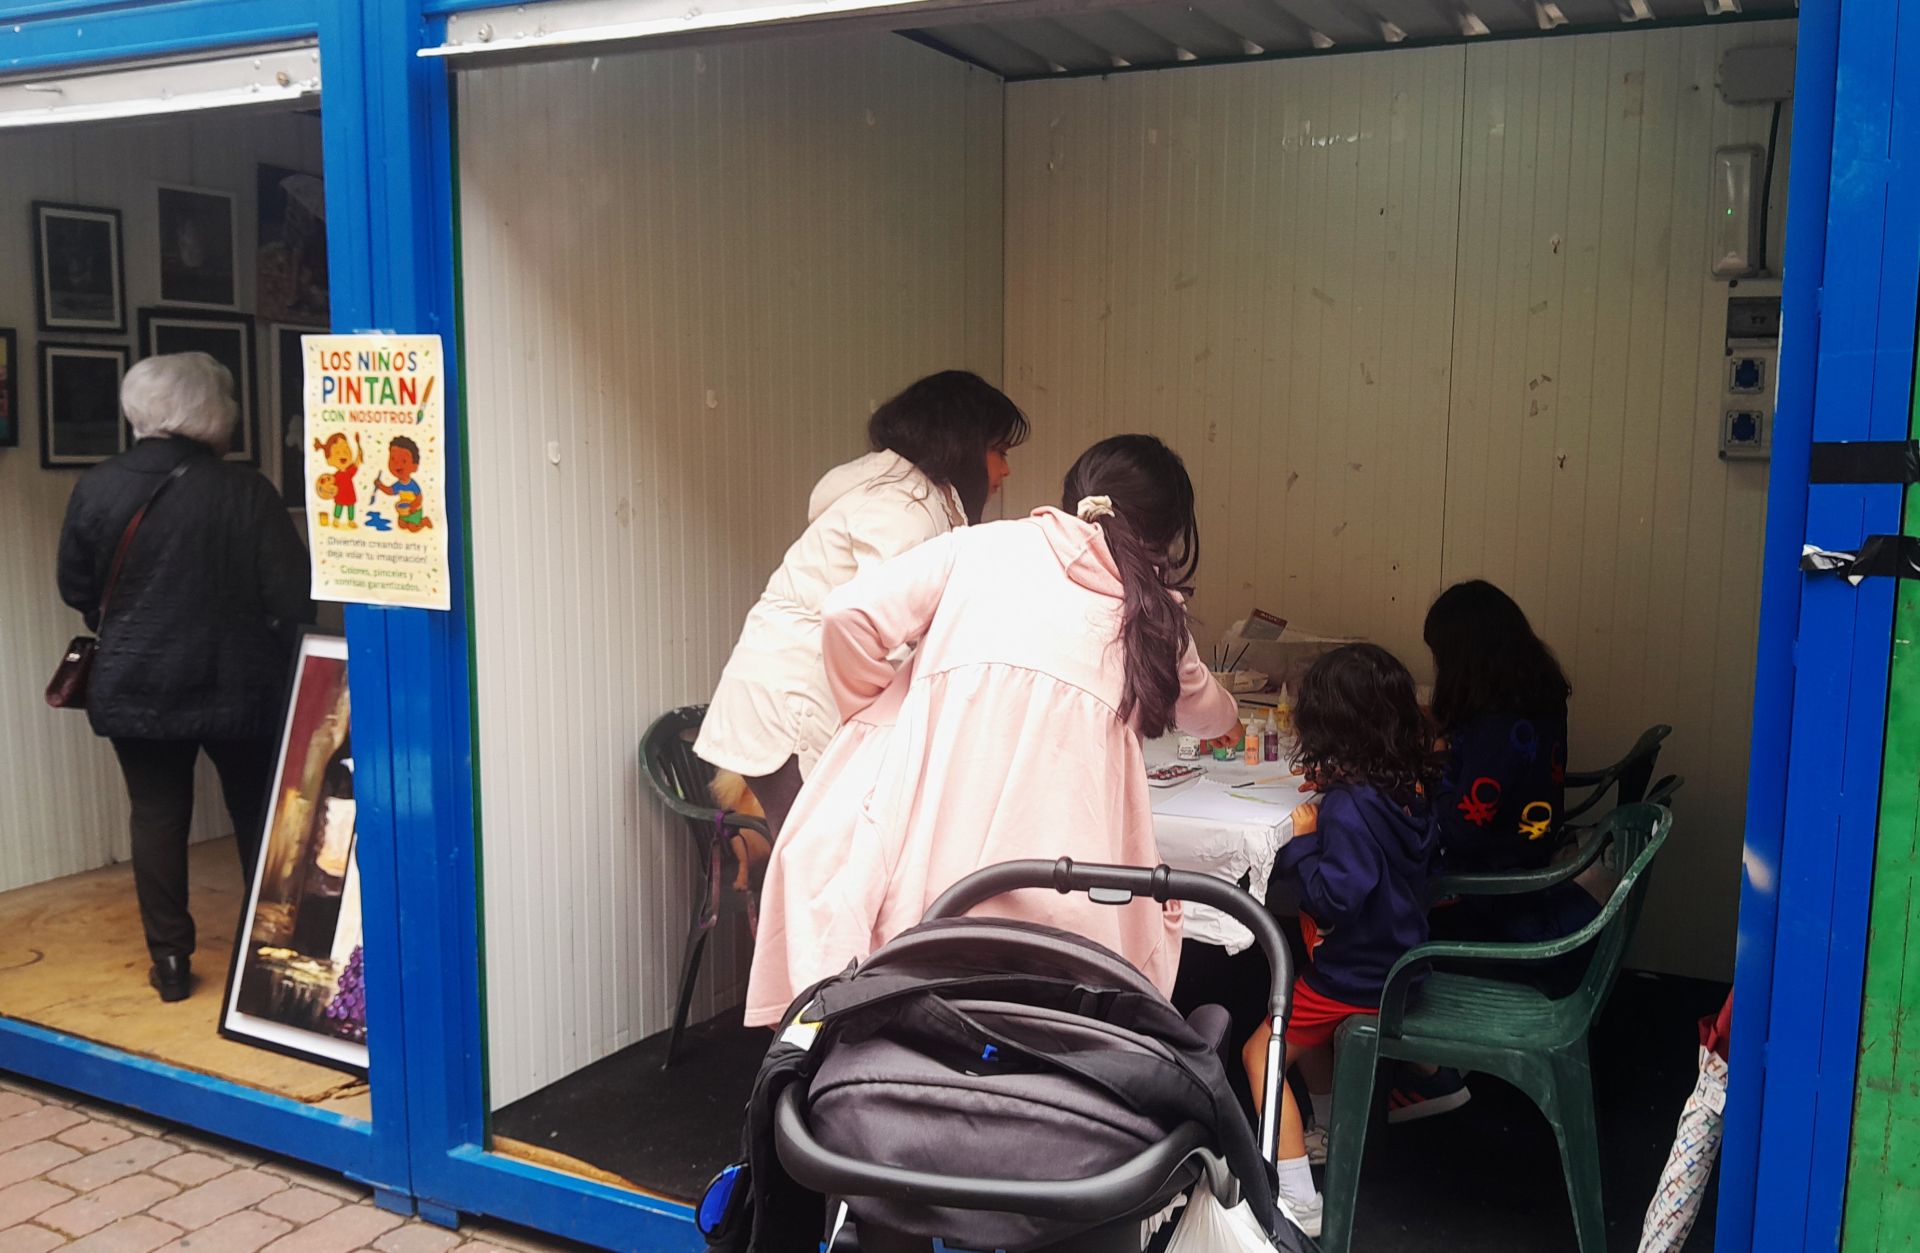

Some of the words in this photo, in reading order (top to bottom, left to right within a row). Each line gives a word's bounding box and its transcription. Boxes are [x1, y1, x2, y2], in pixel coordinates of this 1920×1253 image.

[320, 350, 352, 371] LOS
[358, 347, 417, 371] NIÑOS
[322, 375, 417, 405] PINTAN
[322, 409, 346, 422] CON
[349, 410, 414, 425] NOSOTROS
[405, 542, 421, 551] arte
[366, 552, 375, 560] tu
